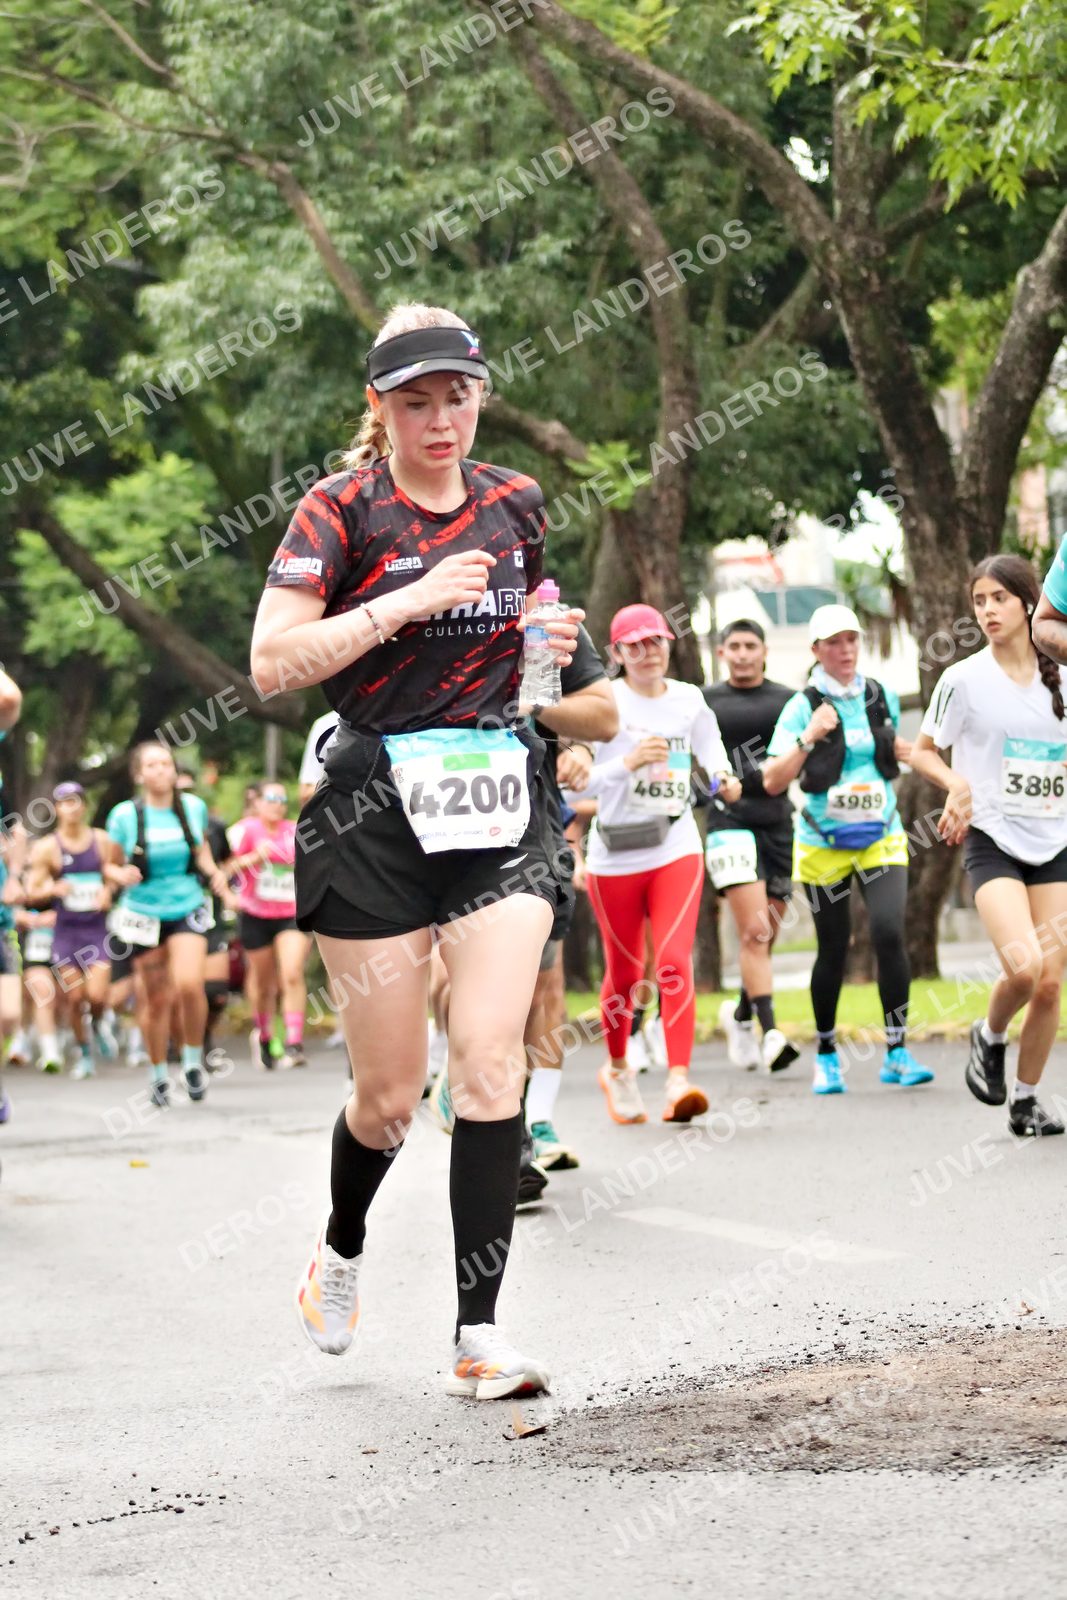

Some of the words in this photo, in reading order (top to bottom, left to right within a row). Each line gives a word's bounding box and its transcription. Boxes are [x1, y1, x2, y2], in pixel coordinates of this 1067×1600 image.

[424, 621, 507, 638] CULIACÁN
[634, 780, 686, 799] 4639
[1005, 773, 1065, 797] 3896
[409, 774, 522, 819] 4200
[833, 792, 883, 810] 3989
